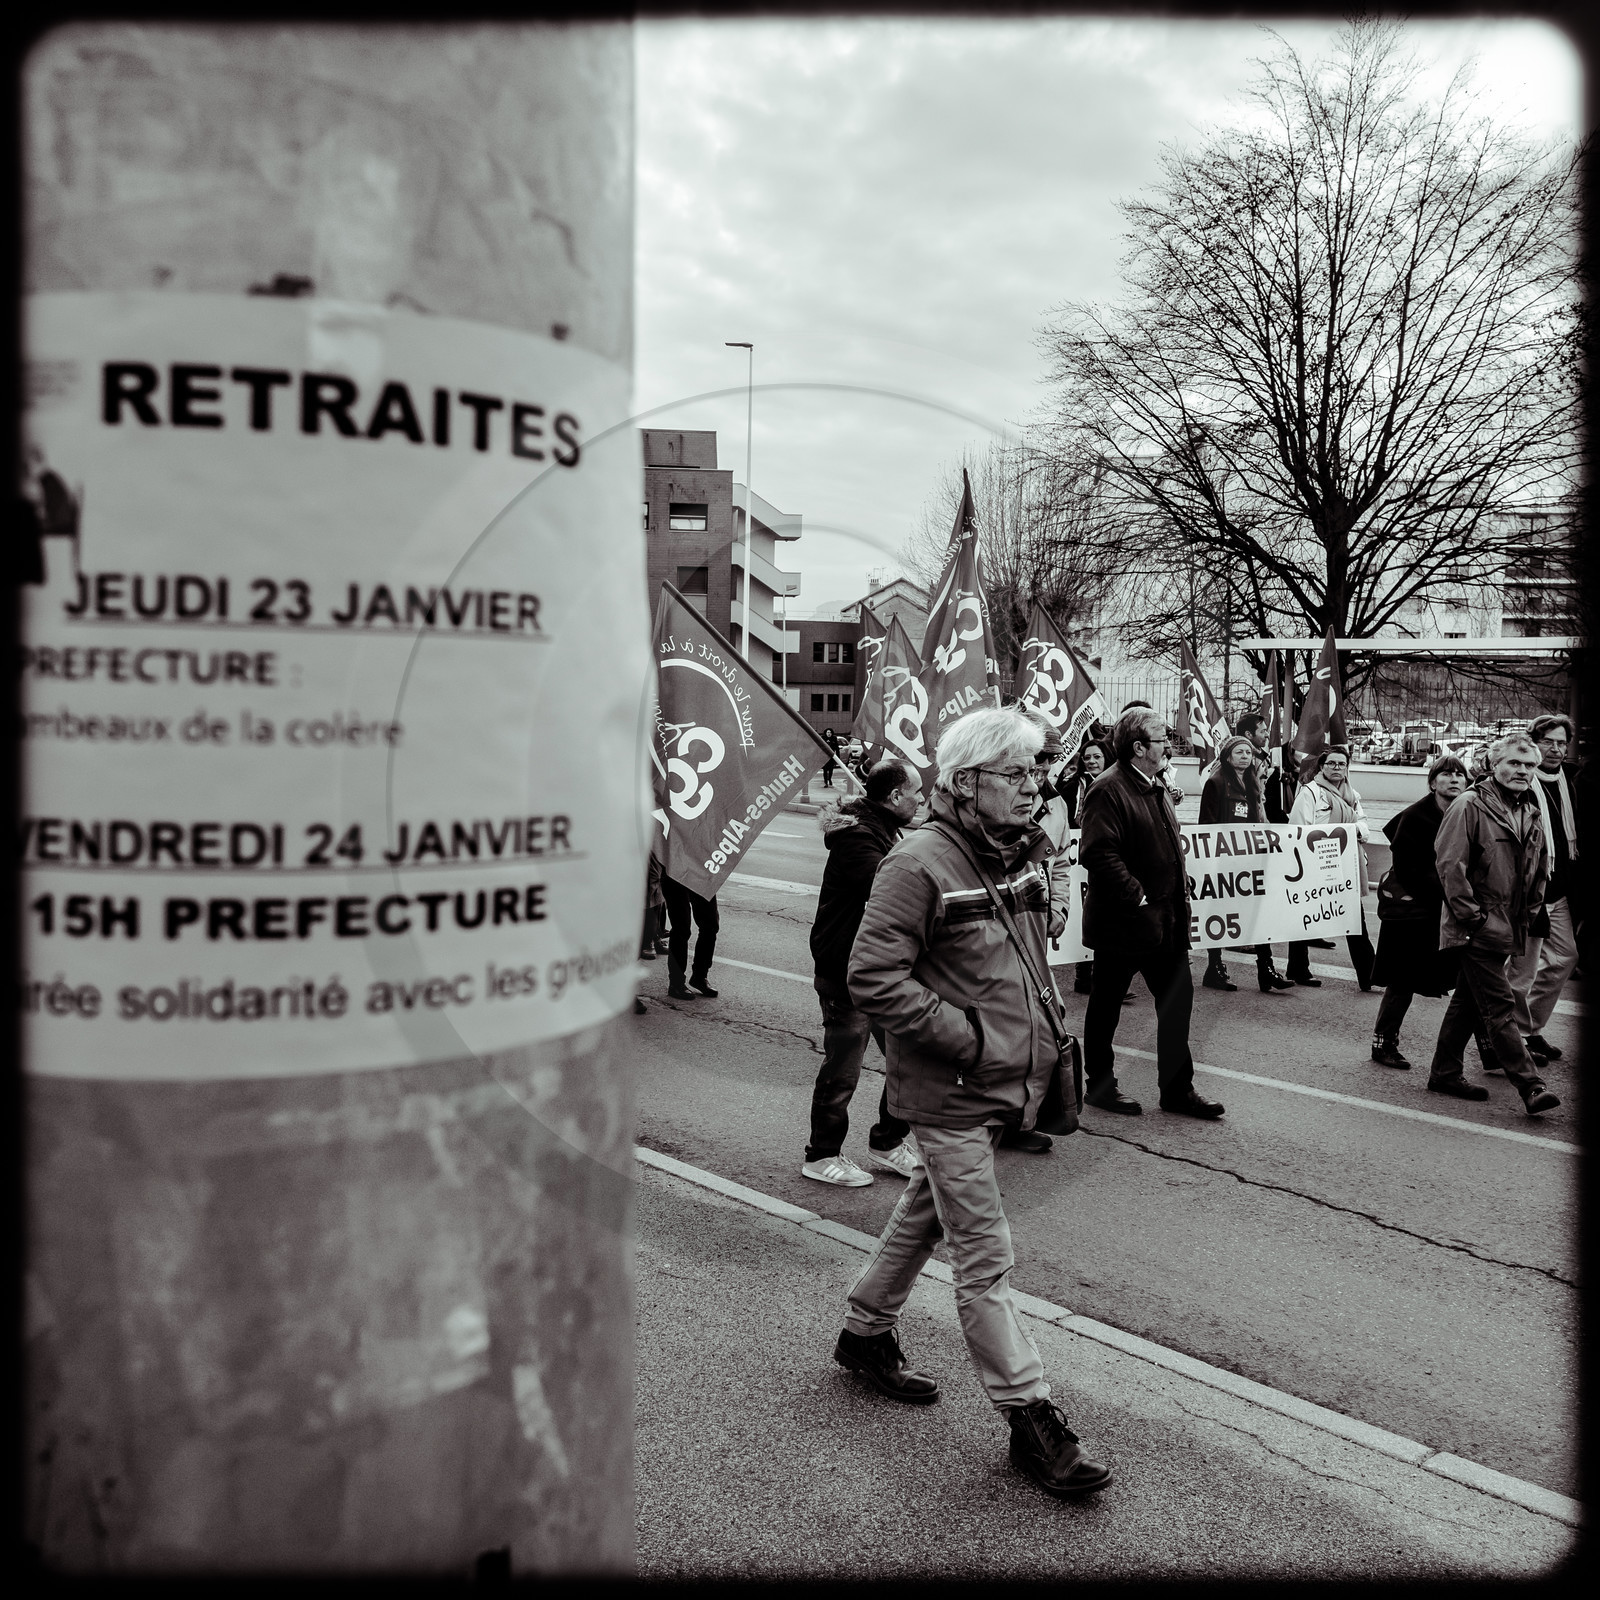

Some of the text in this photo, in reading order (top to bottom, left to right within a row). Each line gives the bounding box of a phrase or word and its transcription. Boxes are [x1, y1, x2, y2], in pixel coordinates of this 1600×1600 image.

[101, 361, 584, 469] RETRAITES
[65, 573, 543, 633] JEUDI 23 JANVIER
[181, 709, 230, 745] de
[241, 711, 277, 748] la
[286, 711, 406, 748] colère
[304, 824, 365, 868] 24
[384, 814, 573, 865] JANVIER
[31, 884, 548, 940] 15H PREFECTURE
[1286, 879, 1353, 905] le service
[1302, 900, 1346, 931] public
[116, 977, 351, 1023] solidarité
[365, 971, 475, 1017] avec
[486, 962, 539, 1002] les
